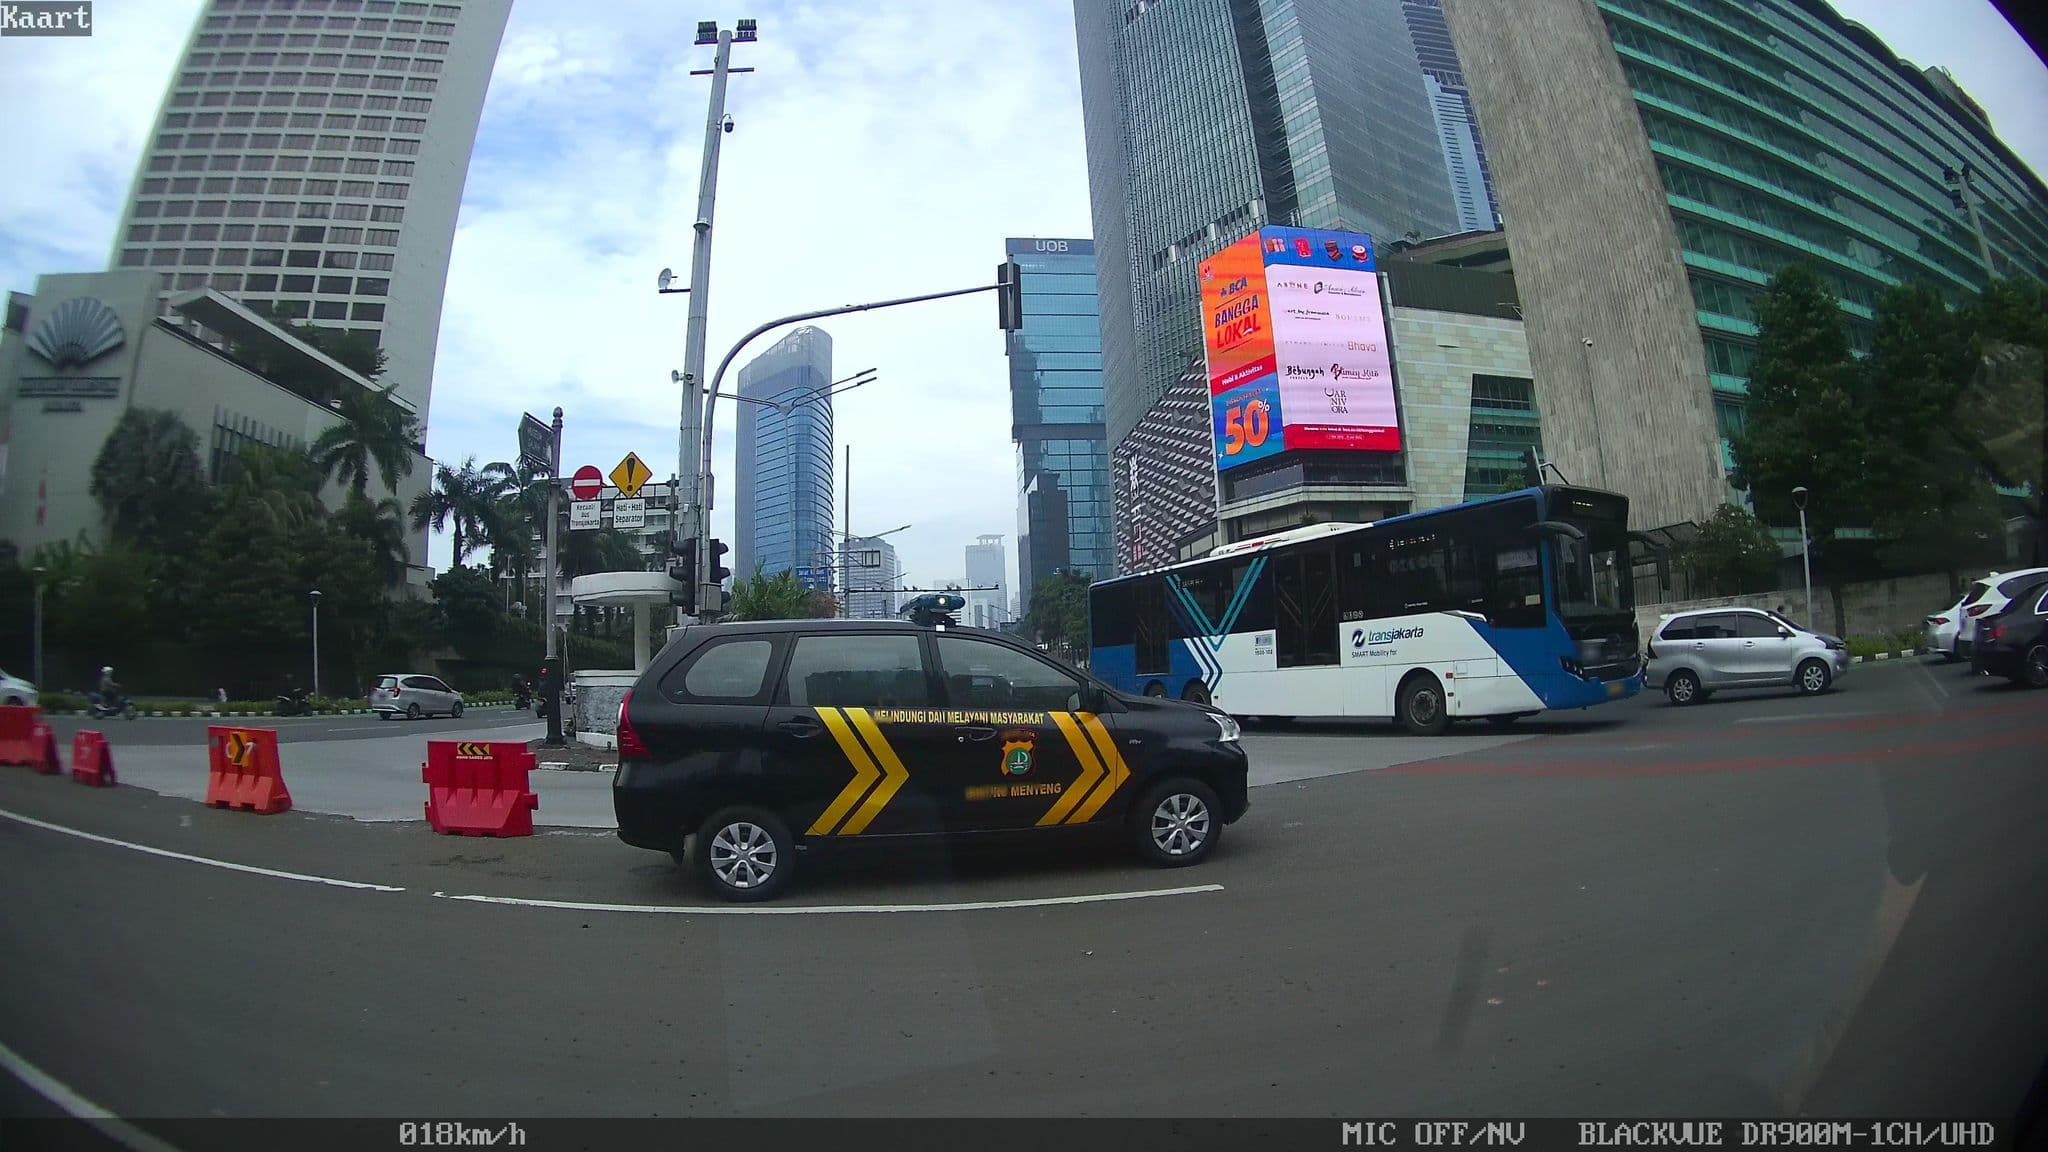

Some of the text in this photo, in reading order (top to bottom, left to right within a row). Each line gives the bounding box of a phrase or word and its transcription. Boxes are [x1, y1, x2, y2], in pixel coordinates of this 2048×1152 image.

[1035, 240, 1068, 252] UOB
[1229, 276, 1248, 295] BCA
[1215, 294, 1258, 328] BANGGA
[1217, 313, 1262, 348] LOKAL
[1225, 398, 1271, 455] 50%
[615, 514, 643, 524] Separator
[1368, 626, 1424, 643] transjakarta
[1351, 650, 1369, 658] SMART
[1370, 649, 1389, 657] Mobility
[947, 711, 988, 723] MELAYANI
[990, 712, 1044, 725] MASYARAKAT
